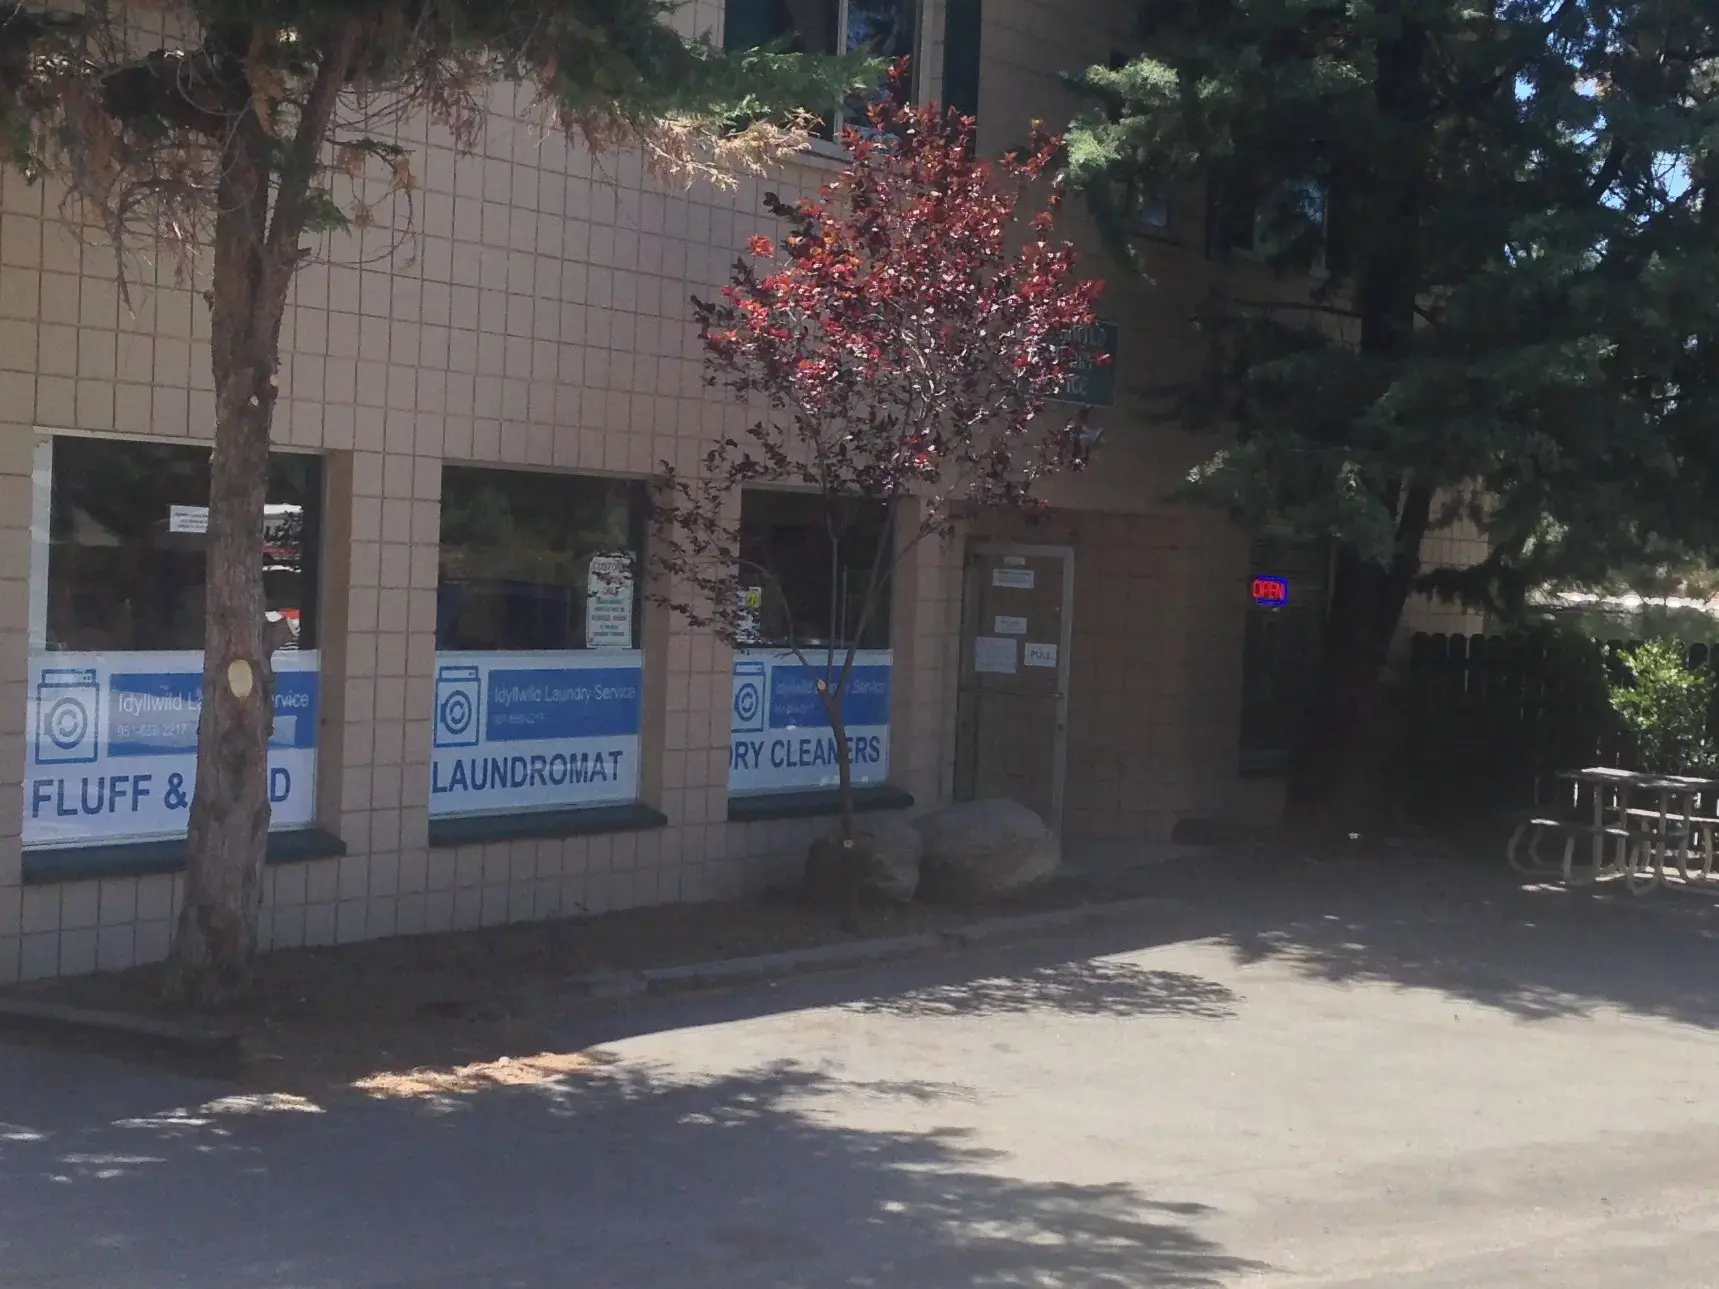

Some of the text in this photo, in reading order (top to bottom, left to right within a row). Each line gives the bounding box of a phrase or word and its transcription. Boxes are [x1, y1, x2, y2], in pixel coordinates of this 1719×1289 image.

[1253, 580, 1284, 600] OPEN
[272, 690, 309, 709] rvice
[545, 685, 590, 704] Laundry
[595, 683, 636, 700] Service
[770, 735, 880, 769] CLEANERS
[432, 750, 623, 793] LAUNDROMAT
[32, 772, 189, 818] FLUFF &
